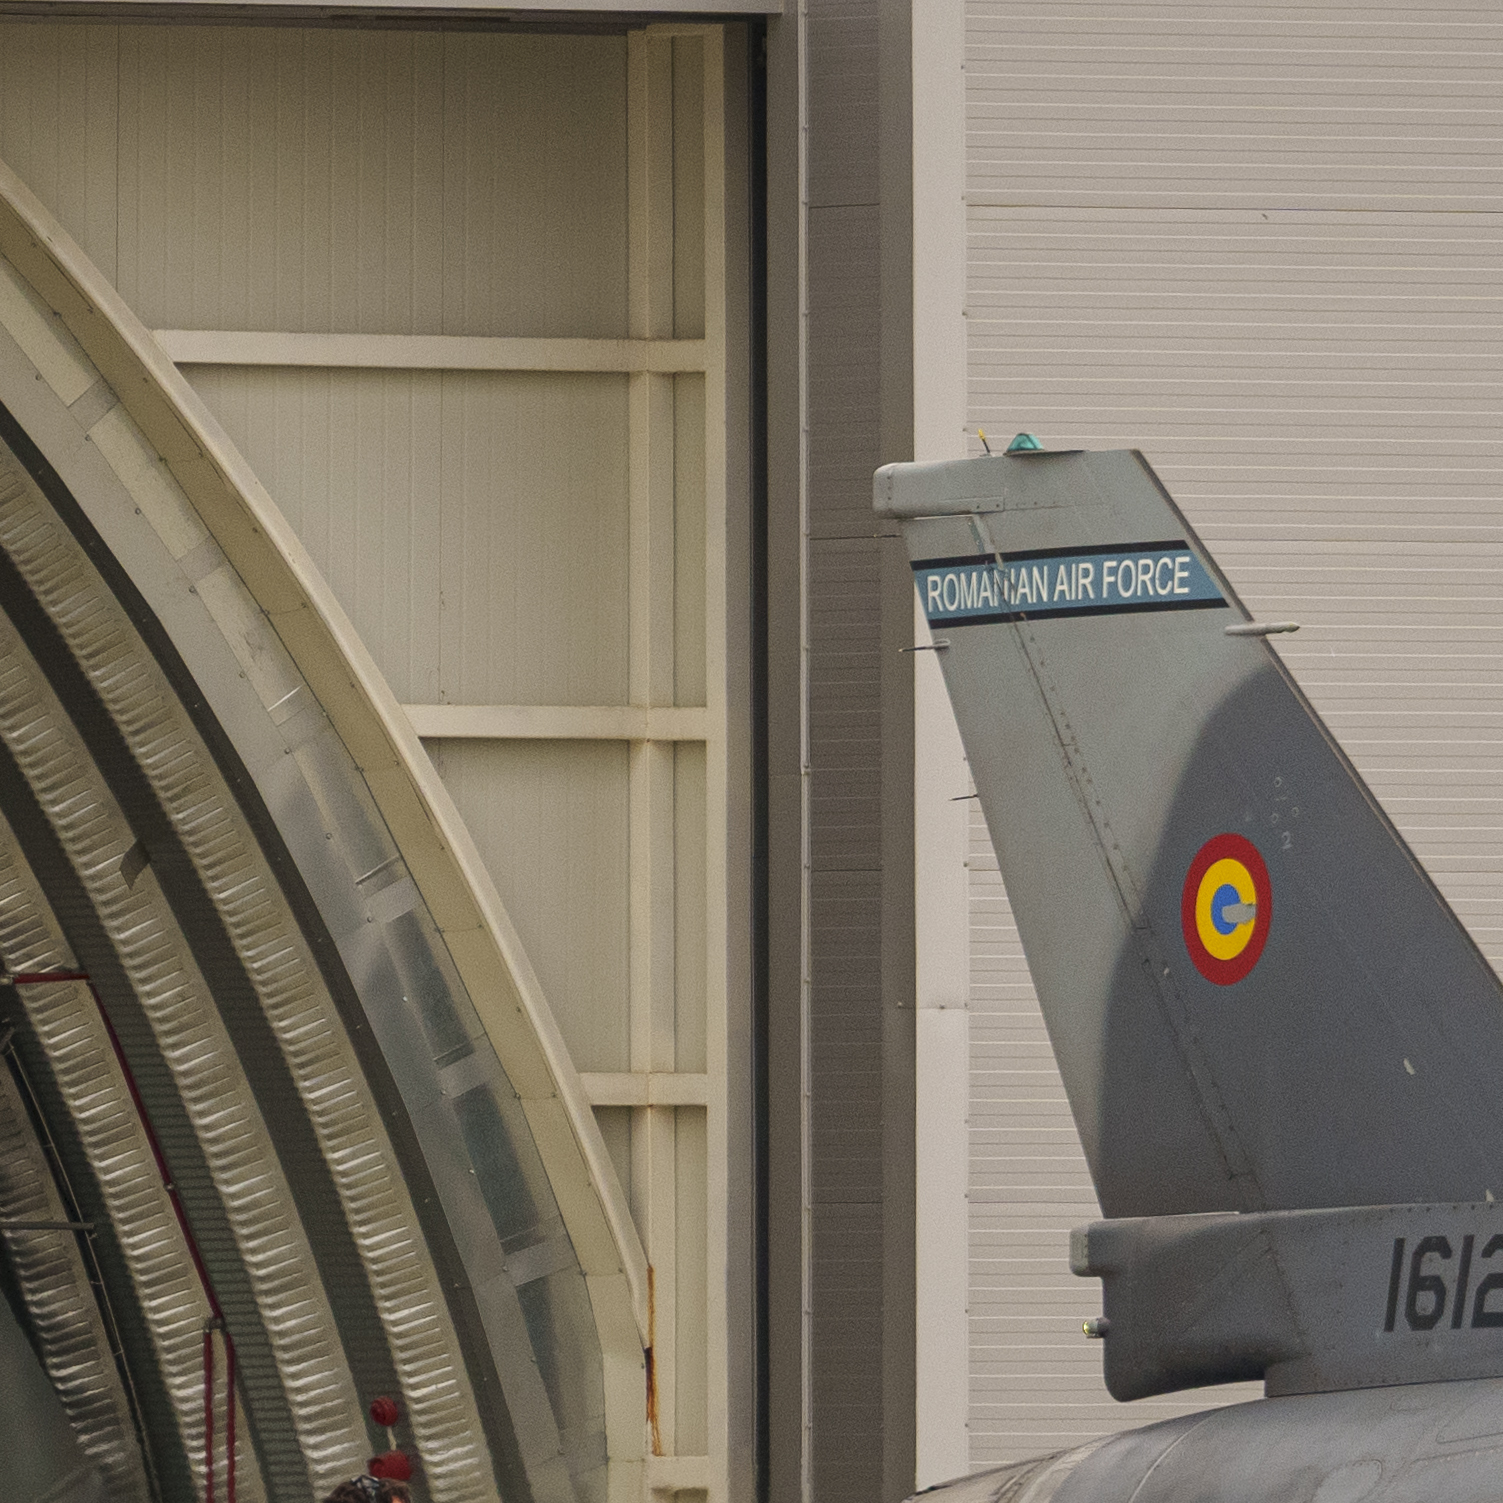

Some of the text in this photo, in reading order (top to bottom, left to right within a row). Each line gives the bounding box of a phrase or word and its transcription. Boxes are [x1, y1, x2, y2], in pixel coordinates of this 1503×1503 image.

[926, 556, 1191, 613] ROMANIAN AIR FORCE
